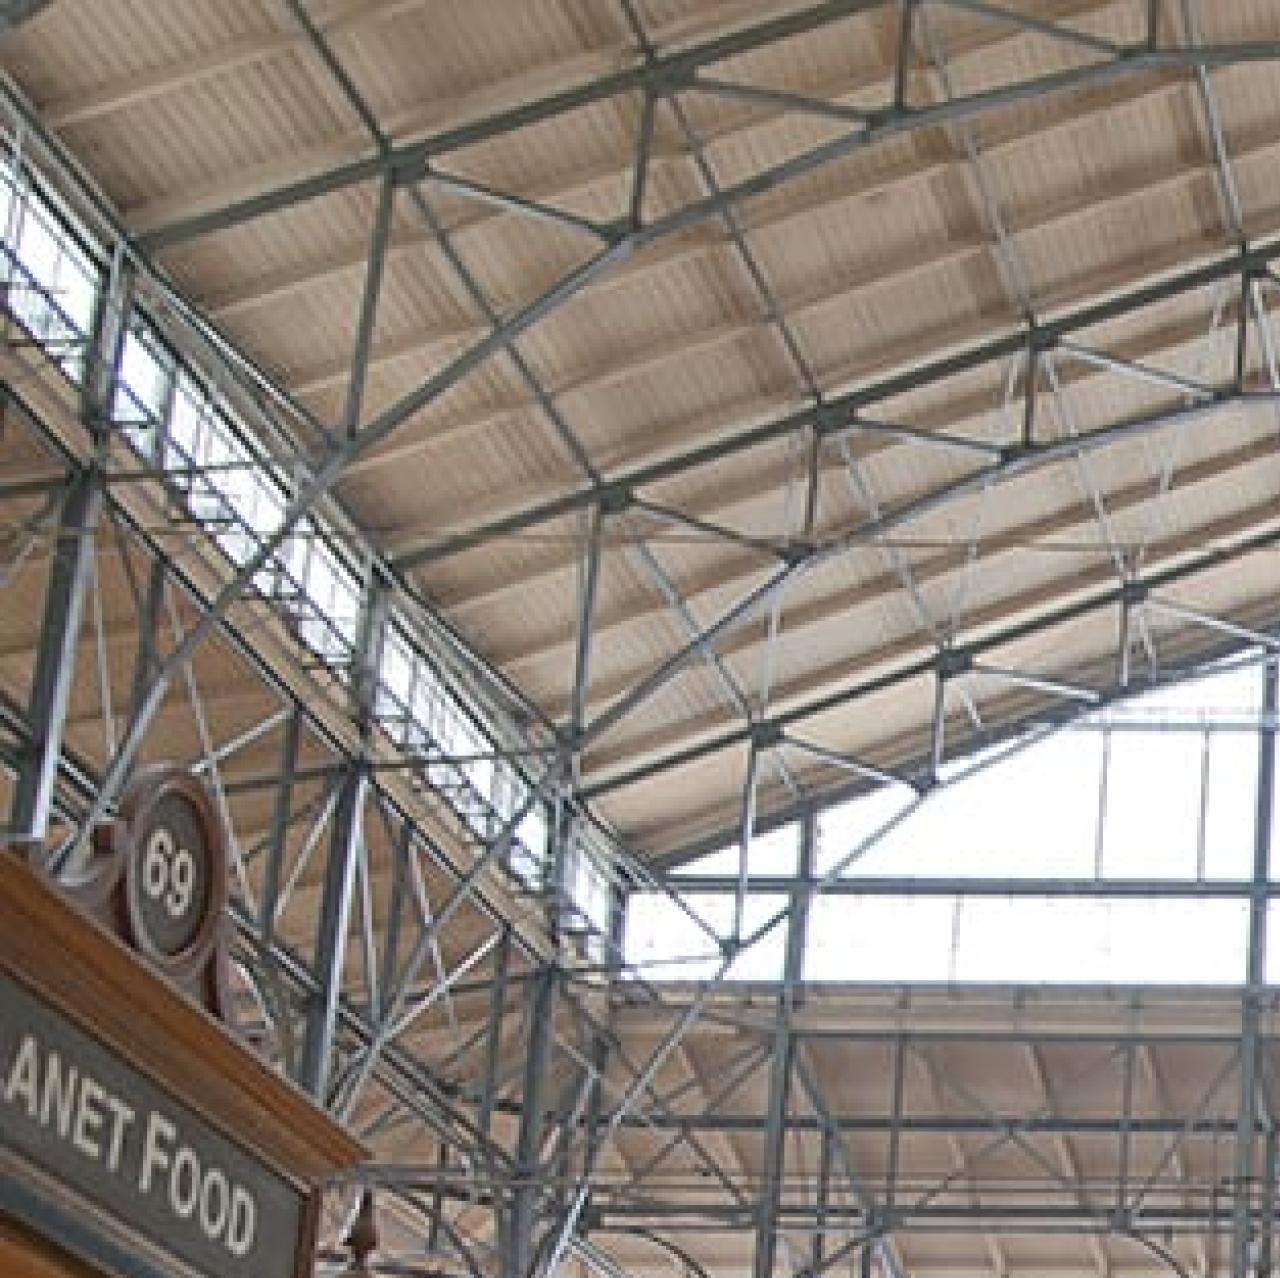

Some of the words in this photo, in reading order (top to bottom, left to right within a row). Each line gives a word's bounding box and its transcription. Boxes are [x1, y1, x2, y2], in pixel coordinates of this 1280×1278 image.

[141, 829, 196, 915] 69
[0, 1036, 136, 1169] ANET
[138, 1111, 255, 1255] FOOD
